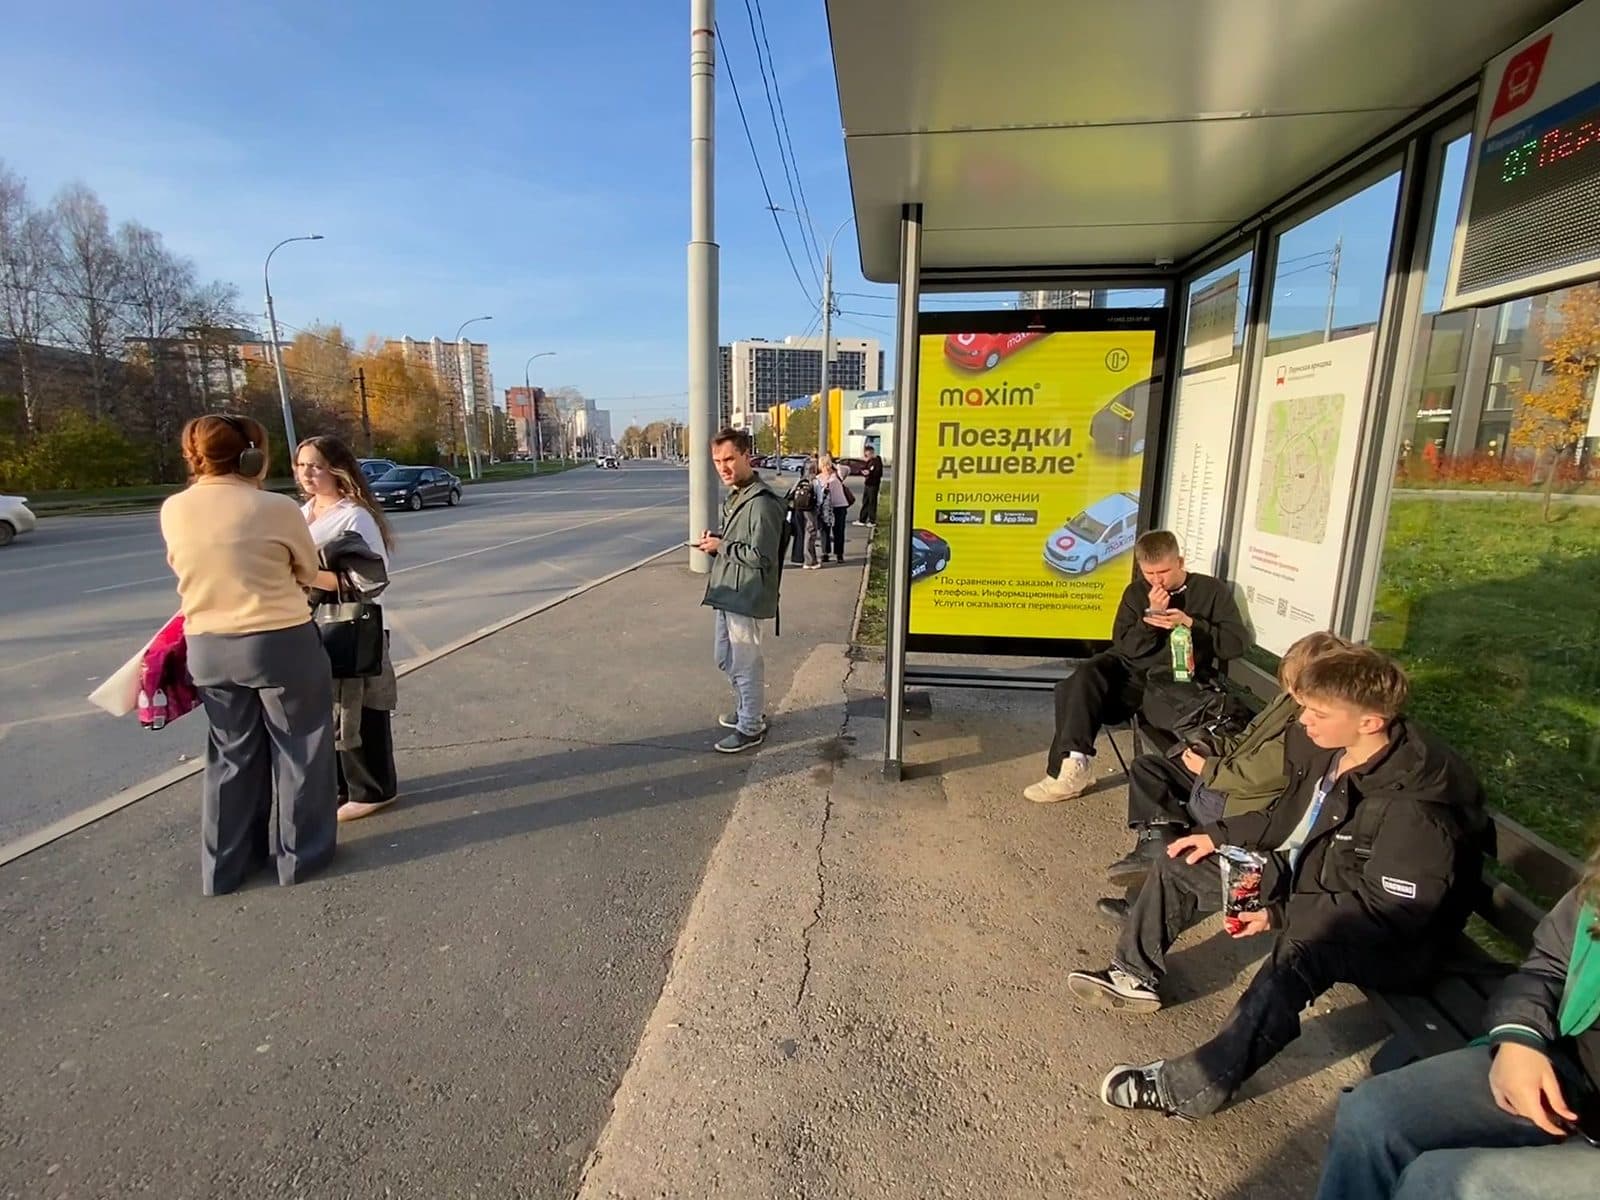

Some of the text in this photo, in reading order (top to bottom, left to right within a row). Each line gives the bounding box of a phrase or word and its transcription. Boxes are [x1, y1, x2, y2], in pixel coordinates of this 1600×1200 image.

[938, 422, 1072, 451] Поездки
[936, 492, 1041, 506] в приложении
[949, 515, 983, 523] Google Play
[941, 577, 953, 585] По
[955, 578, 1006, 588] сравнению
[1016, 580, 1054, 588] заказом
[1069, 581, 1105, 590] номеру
[934, 589, 978, 599] телефона.
[982, 588, 1067, 600] Информационный
[934, 599, 1103, 612] Услуги оказываются перевозчиками.
